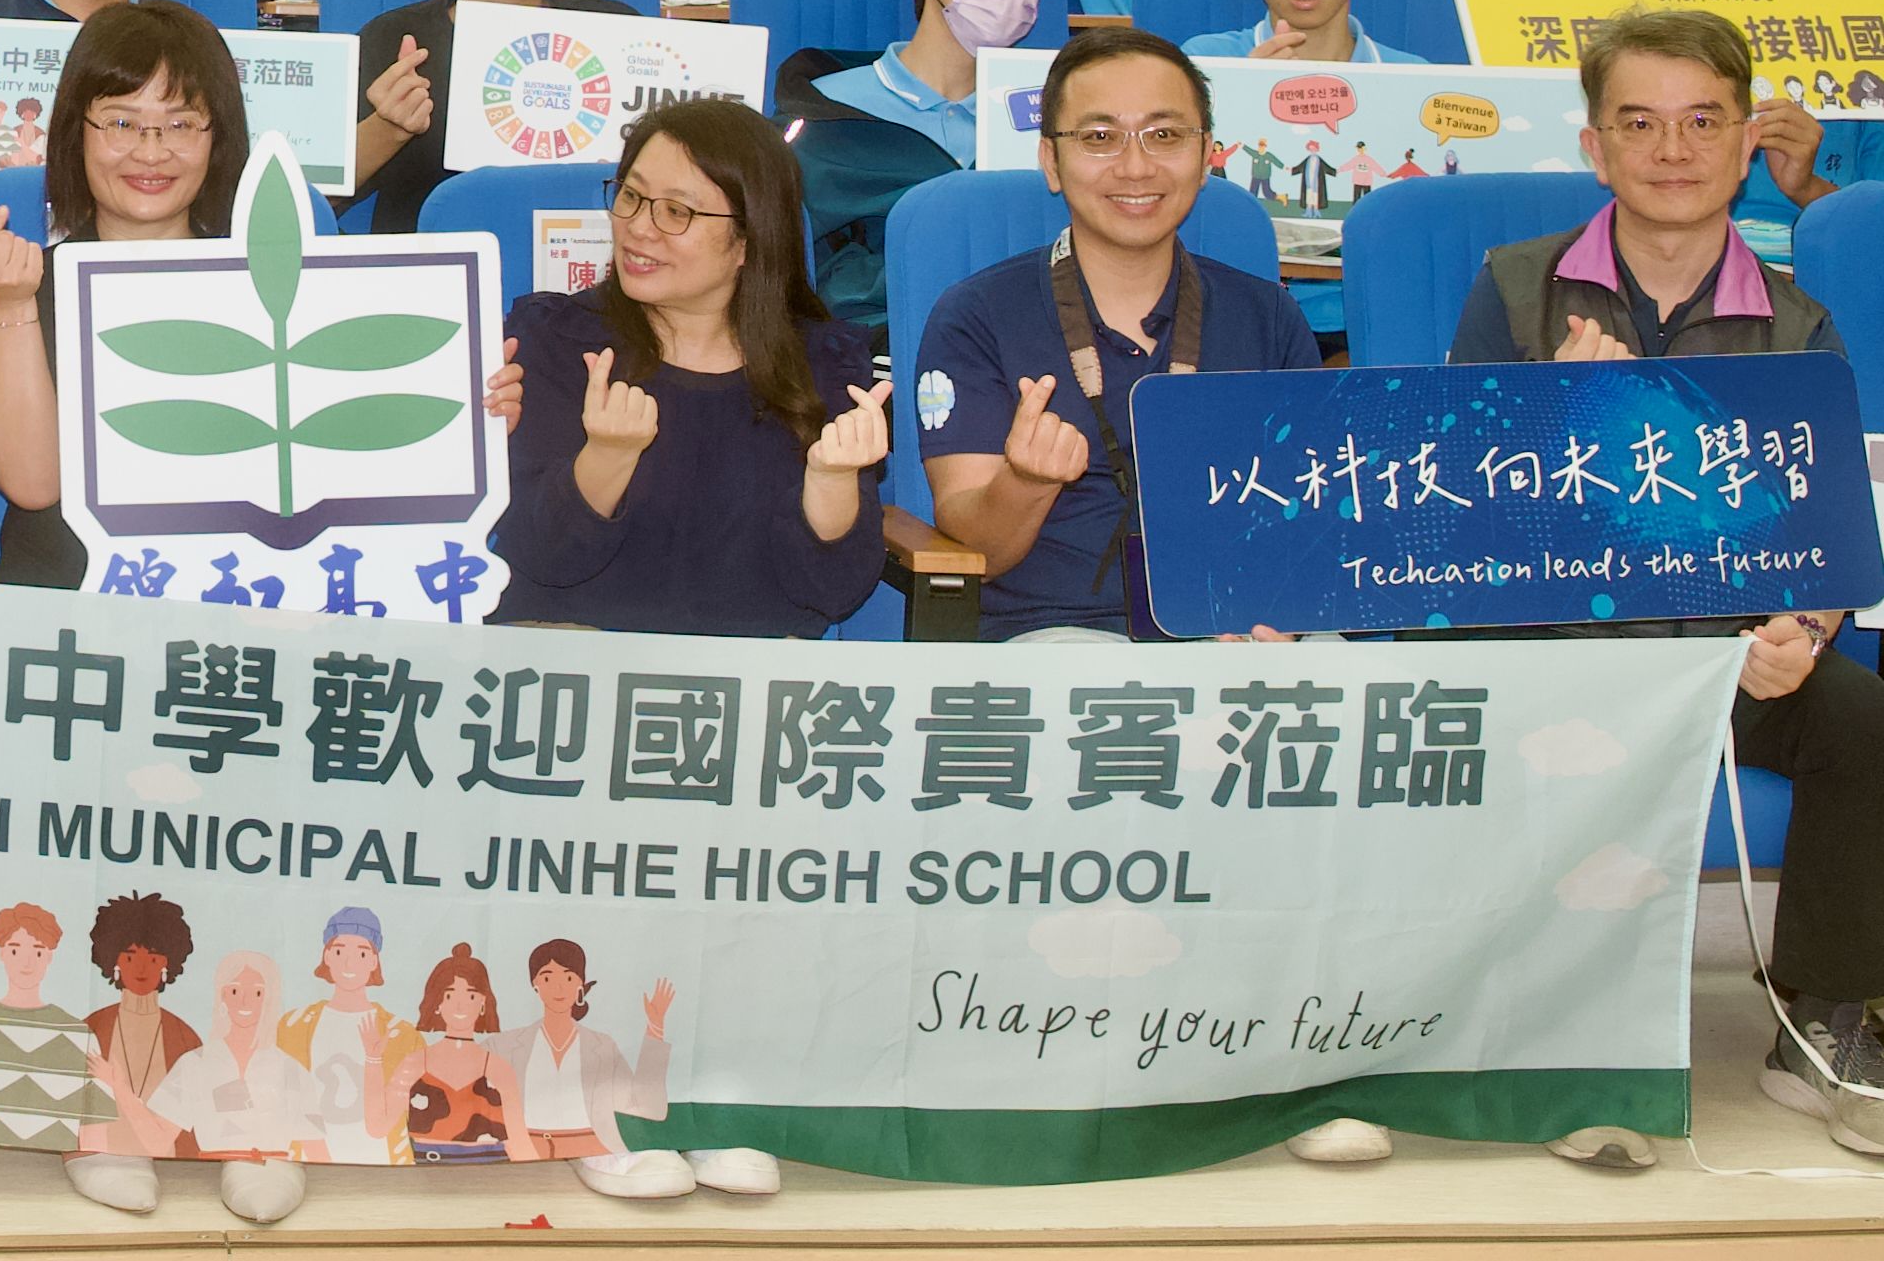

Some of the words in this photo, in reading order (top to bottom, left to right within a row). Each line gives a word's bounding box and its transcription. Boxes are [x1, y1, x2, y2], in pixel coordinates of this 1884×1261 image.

[627, 55, 664, 67] Global
[626, 65, 660, 77] Goals
[523, 81, 572, 91] SUSTAINABLE
[1275, 88, 1305, 101] 대만에
[1307, 87, 1327, 99] 오신
[1329, 86, 1349, 98] 것을
[523, 96, 570, 110] GOALS
[621, 86, 745, 112] JIN
[1290, 103, 1340, 115] 환영합니다
[1433, 98, 1494, 119] Bienvenue
[1208, 419, 1814, 523] 以科技向未來學習
[1342, 554, 1532, 589] Techcation
[1544, 547, 1632, 582] leads
[1643, 544, 1698, 576] the
[1709, 536, 1826, 583] future
[38, 801, 442, 888] MUNICIPAL
[464, 836, 678, 899] JINHE
[704, 846, 881, 904] HIGH
[906, 850, 1211, 906] SCHOOL
[917, 970, 1111, 1060] Shape
[1137, 1007, 1266, 1070] your
[1290, 990, 1443, 1054] future
